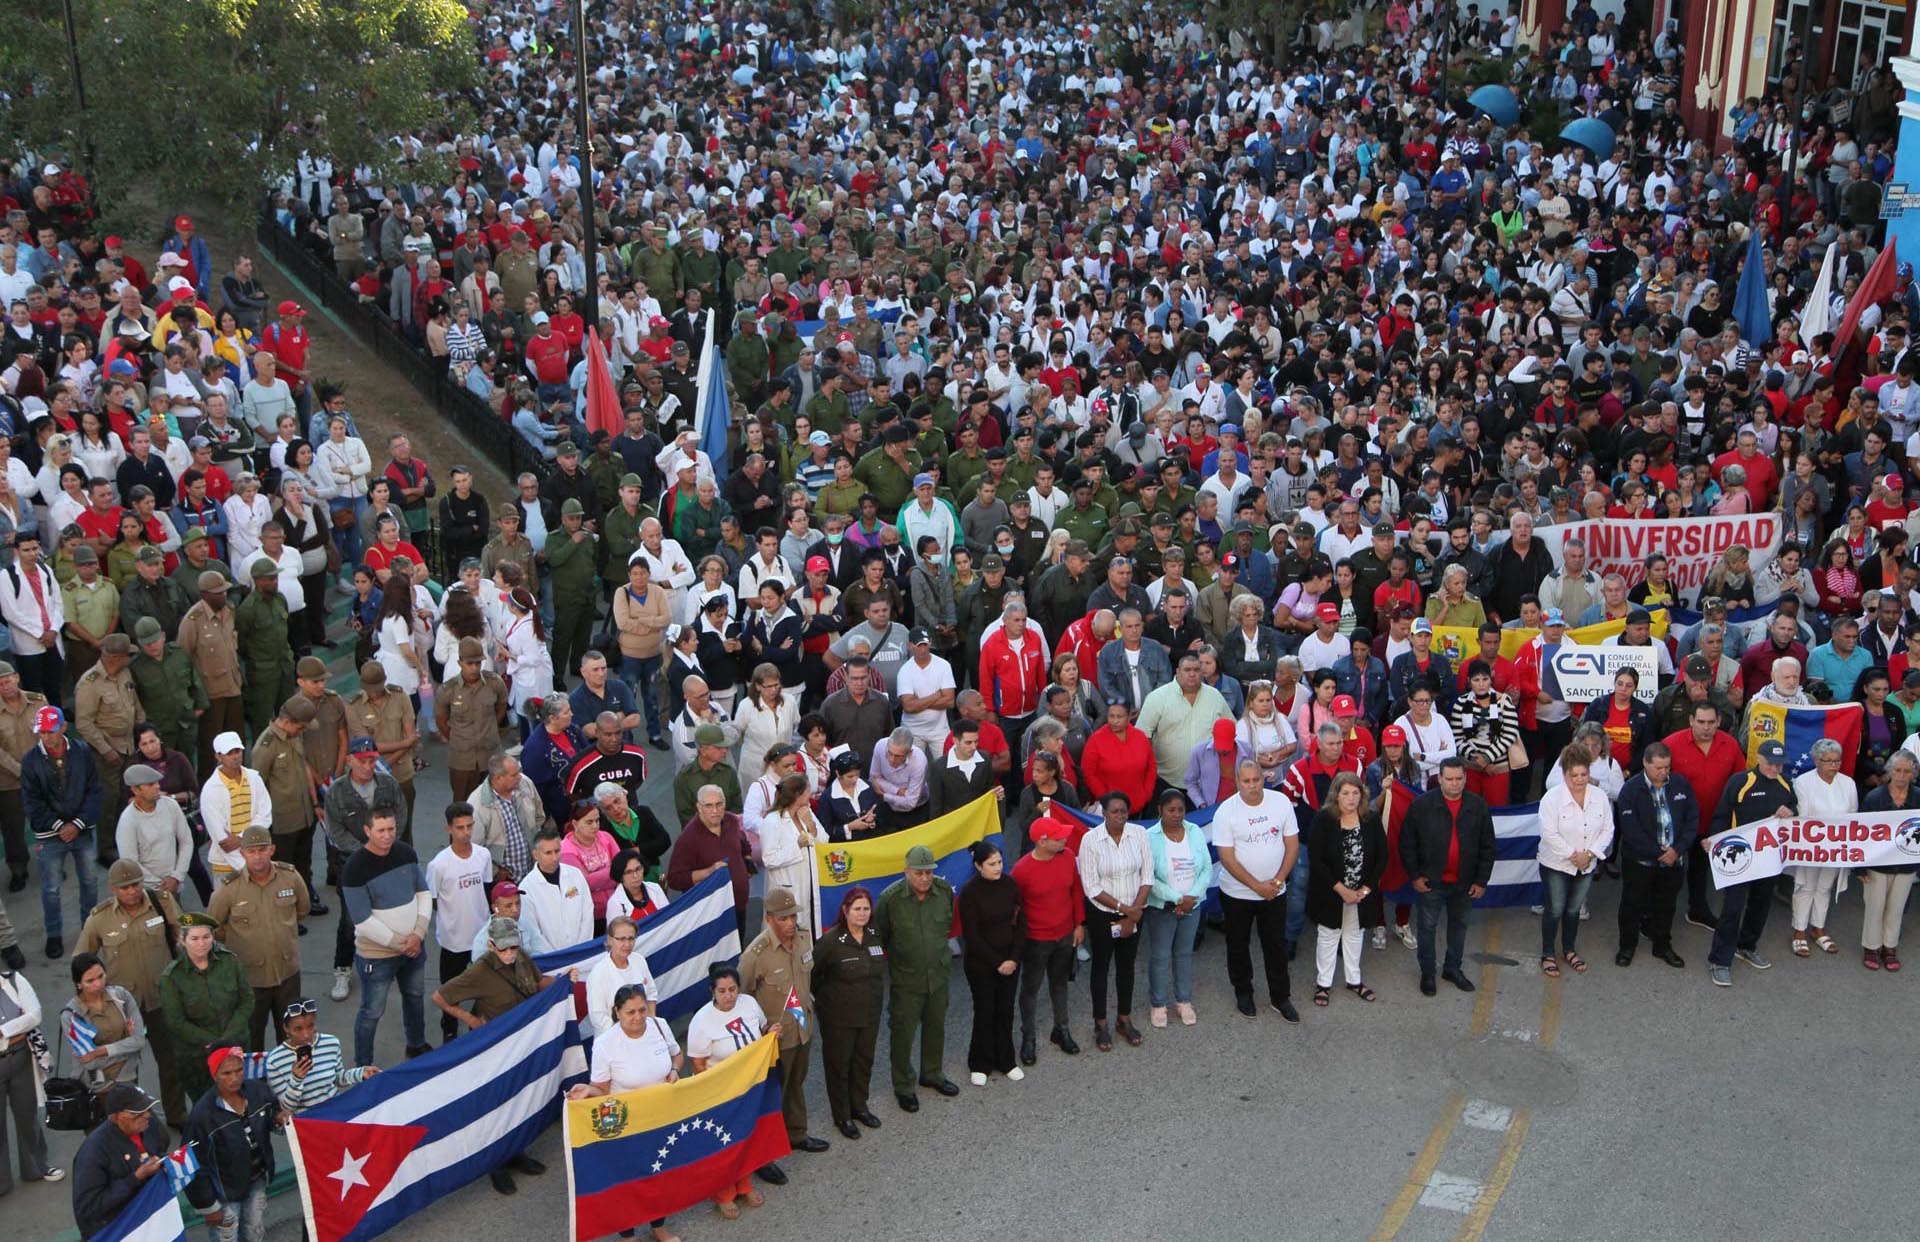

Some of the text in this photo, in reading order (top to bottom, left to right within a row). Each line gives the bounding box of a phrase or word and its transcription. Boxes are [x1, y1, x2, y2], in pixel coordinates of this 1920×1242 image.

[1562, 518, 1774, 559] UNIVERSIDAD
[1607, 661, 1653, 669] ELECTORAL
[1566, 688, 1604, 698] SANCTI
[598, 768, 633, 781] CUBA
[1754, 820, 1892, 852] AsiCuba
[1779, 844, 1865, 864] Umbria
